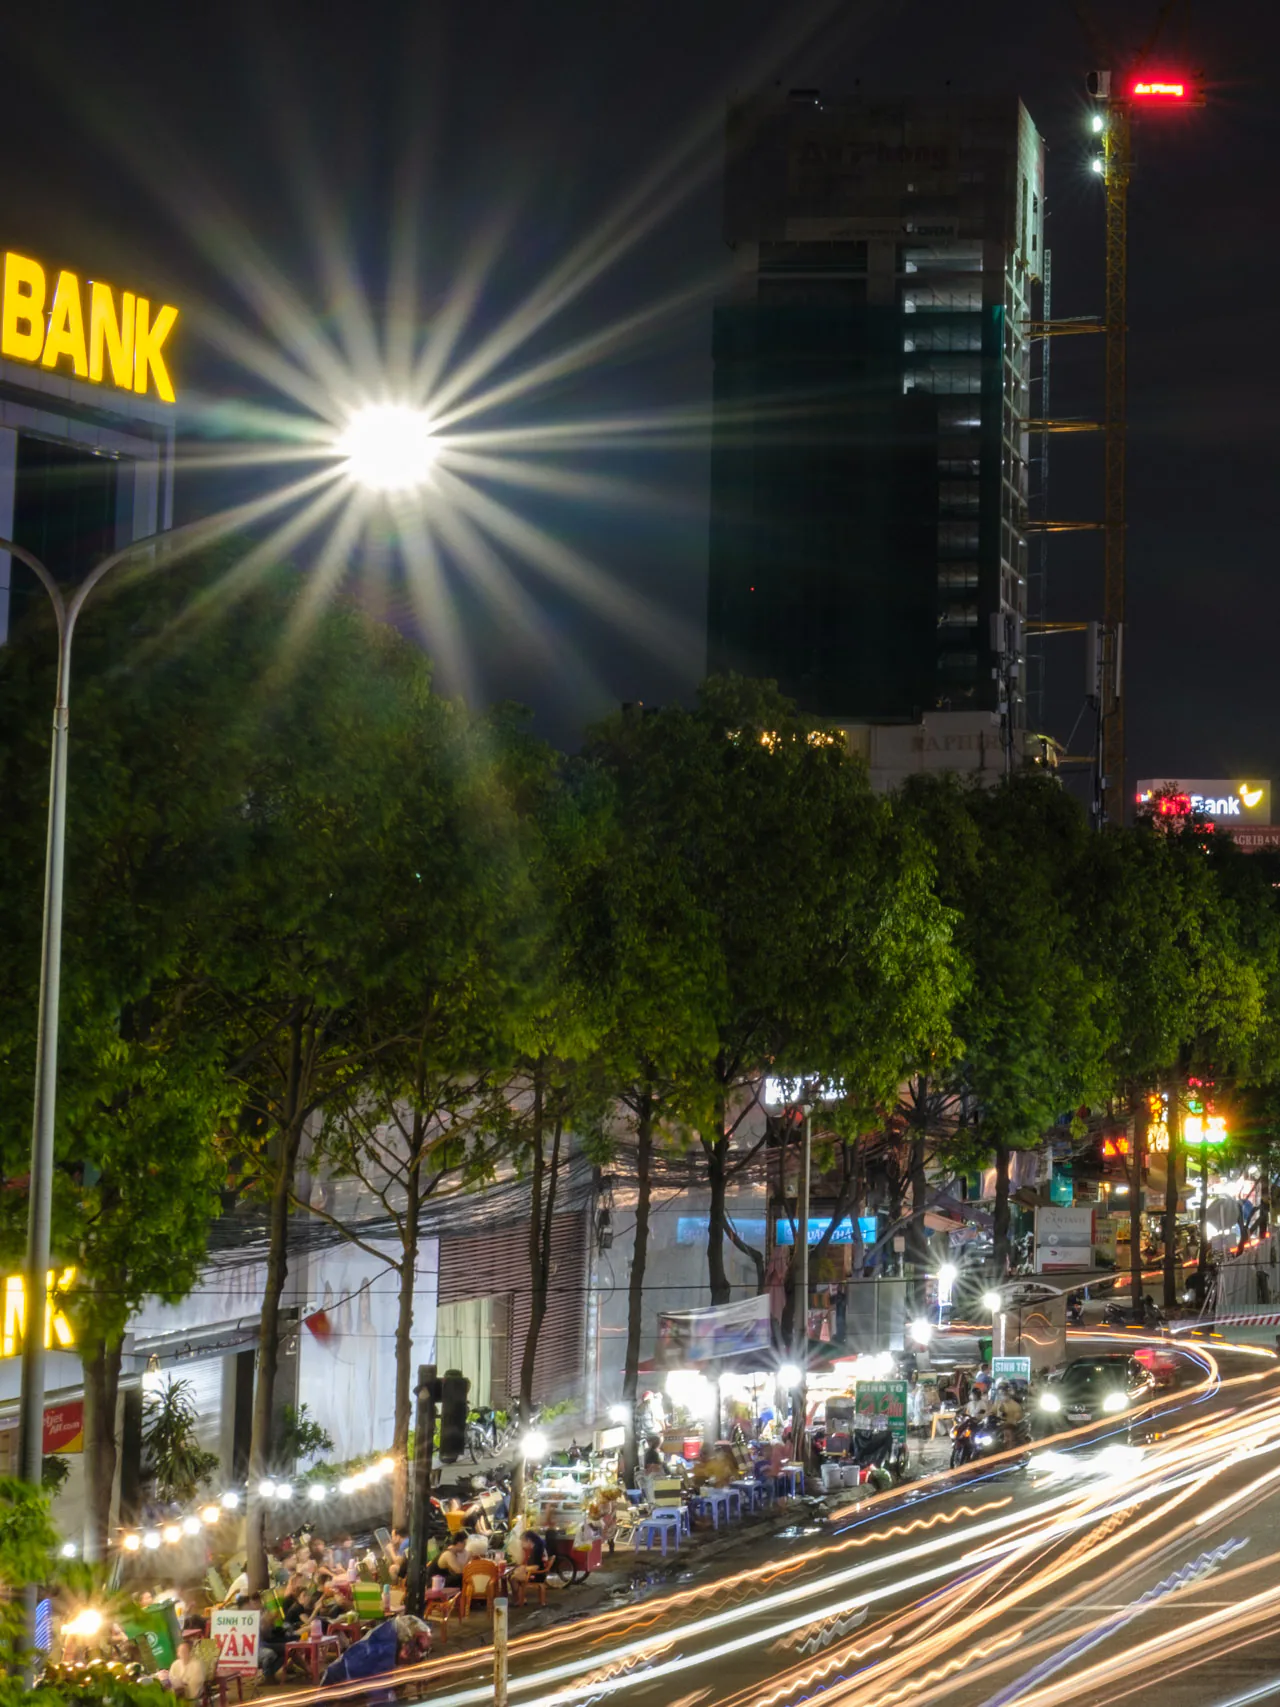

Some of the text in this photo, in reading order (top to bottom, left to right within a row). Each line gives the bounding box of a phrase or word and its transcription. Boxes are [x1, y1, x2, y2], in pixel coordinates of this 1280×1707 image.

[2, 251, 179, 403] BANK
[0, 1266, 76, 1357] NK
[214, 1627, 257, 1657] VÂN
[217, 1616, 239, 1626] SINH
